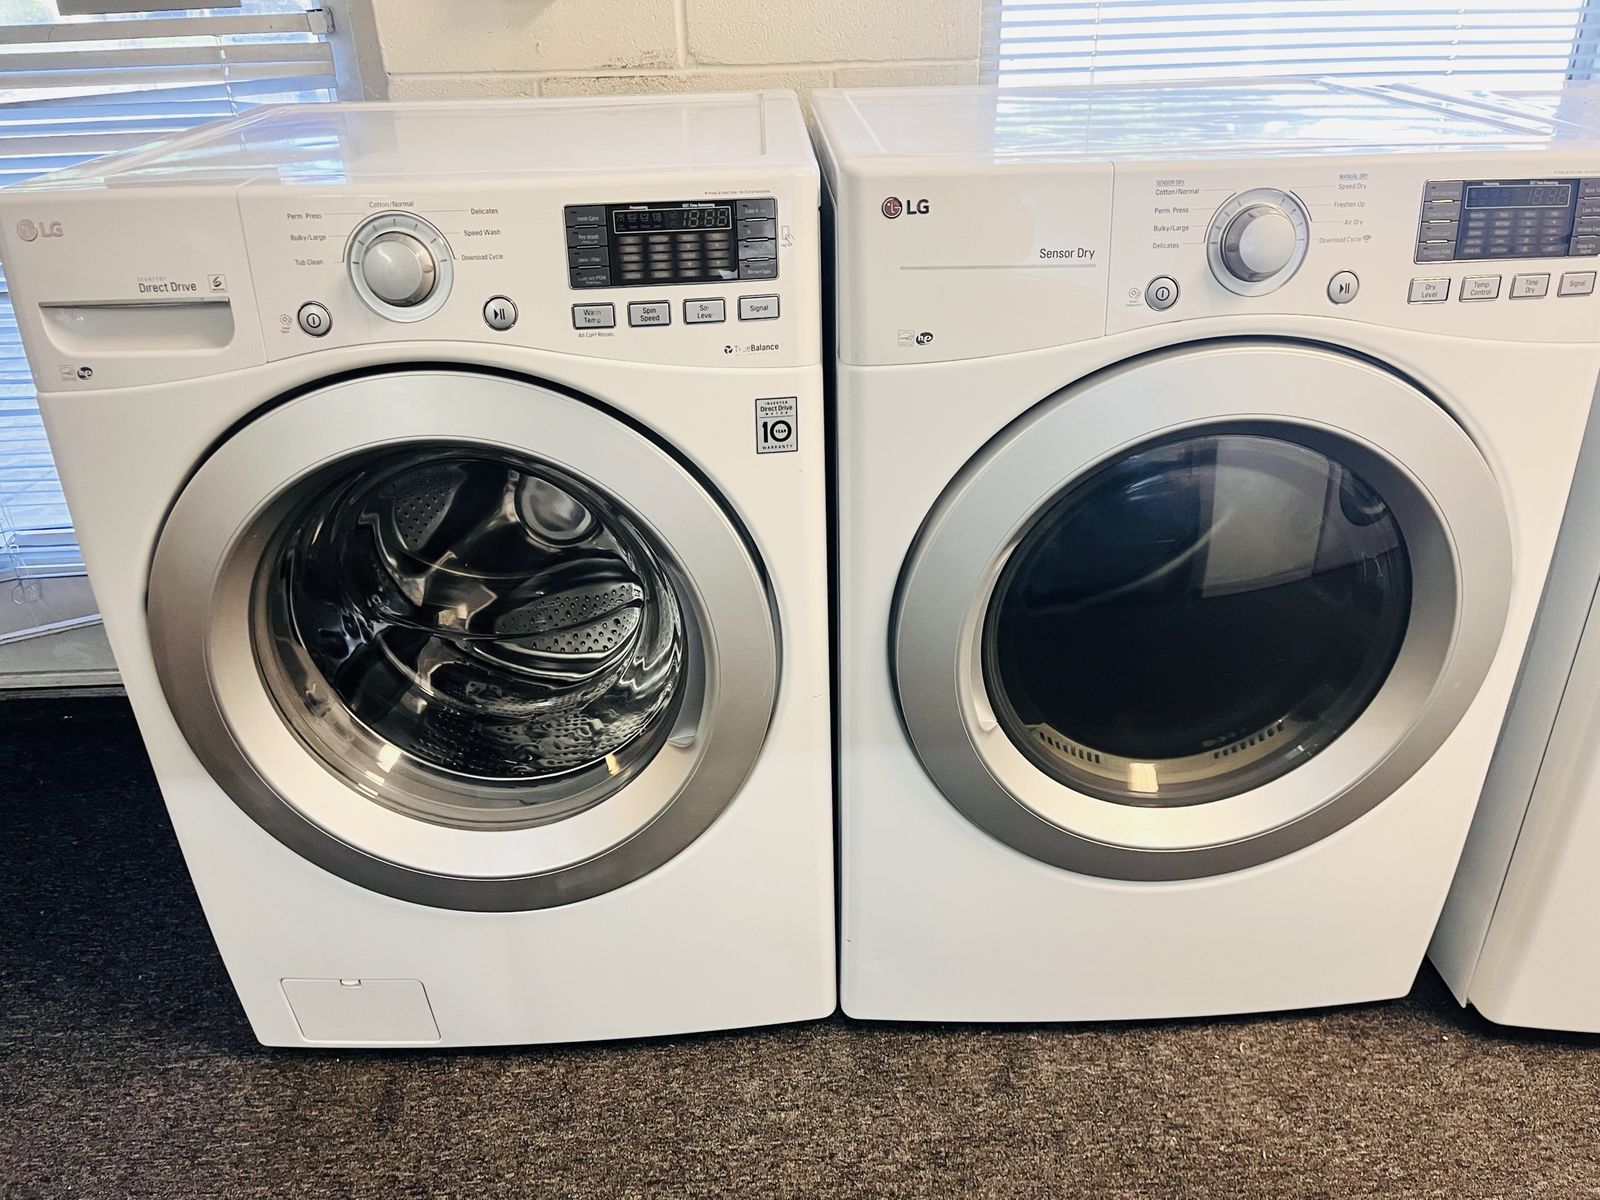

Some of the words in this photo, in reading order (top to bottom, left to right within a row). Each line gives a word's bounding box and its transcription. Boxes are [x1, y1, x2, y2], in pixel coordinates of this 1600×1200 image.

[1357, 183, 1368, 191] Dry
[906, 199, 930, 215] LG
[1334, 201, 1357, 209] Freshen
[1353, 218, 1364, 226] Dry
[41, 221, 64, 239] LG
[1319, 236, 1347, 244] Download
[1346, 235, 1363, 243] Cycle
[1039, 248, 1075, 260] Sensor
[1076, 248, 1096, 260] Dry
[1425, 283, 1437, 291] Dry
[1474, 281, 1490, 289] Temp
[1525, 279, 1539, 287] Time
[1569, 280, 1587, 288] Signal
[138, 282, 169, 294] Direct
[170, 281, 197, 292] Drive
[1525, 286, 1536, 294] Dry
[1421, 290, 1439, 298] Level
[1470, 288, 1492, 296] Control
[642, 307, 657, 315] Spin
[749, 304, 769, 313] Signal
[640, 314, 660, 323] Speed
[696, 312, 713, 320] Leve
[762, 420, 792, 443] 10
